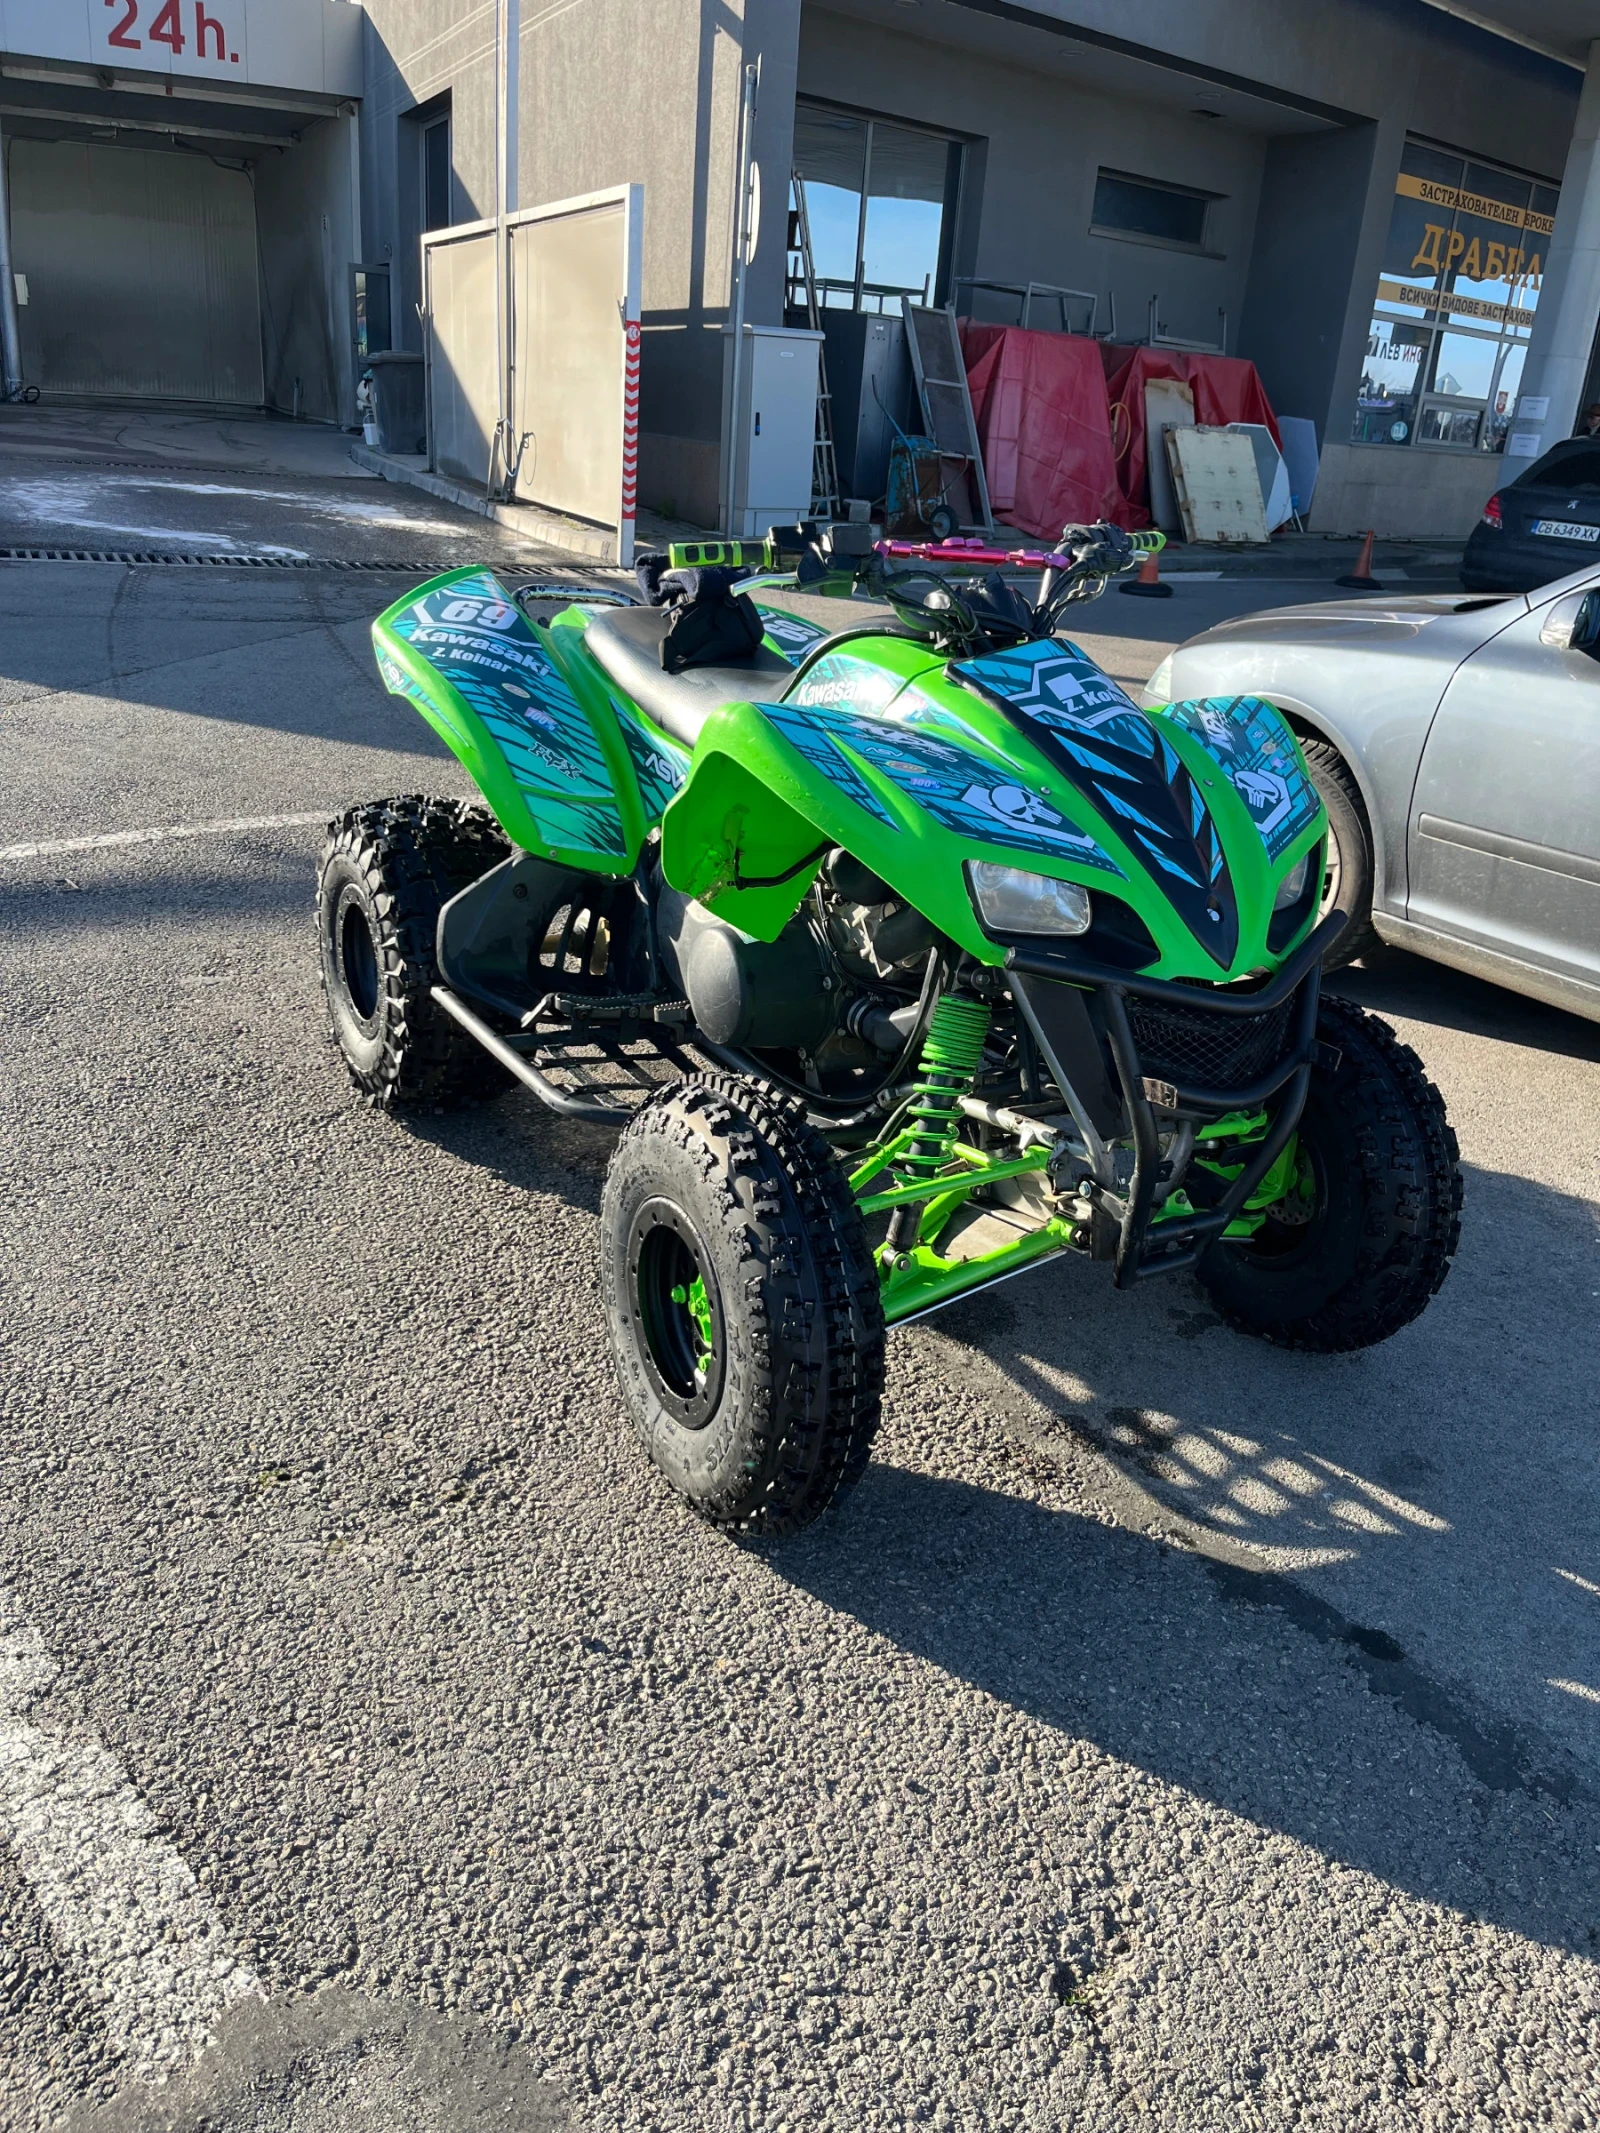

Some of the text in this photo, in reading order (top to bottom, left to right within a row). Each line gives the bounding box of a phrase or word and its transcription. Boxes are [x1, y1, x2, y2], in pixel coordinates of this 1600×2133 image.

[104, 0, 239, 63] 24h.
[1419, 182, 1520, 224] ЗАСТРАХОВАТЕЛЕН
[1410, 223, 1540, 291] ДРАБЕЛ
[1399, 286, 1440, 307] ВСИЧКИ
[1441, 295, 1479, 316] ВИДОВЕ
[1380, 341, 1401, 361] ЛЕВ
[1553, 524, 1581, 538] 6349
[440, 600, 519, 630] 69
[408, 627, 553, 677] Kawasaki
[431, 646, 513, 673] Z. Koinar
[796, 679, 868, 707] Kawasa
[1061, 697, 1085, 713] Z.
[525, 708, 557, 732] 100%
[911, 777, 942, 790] 100%
